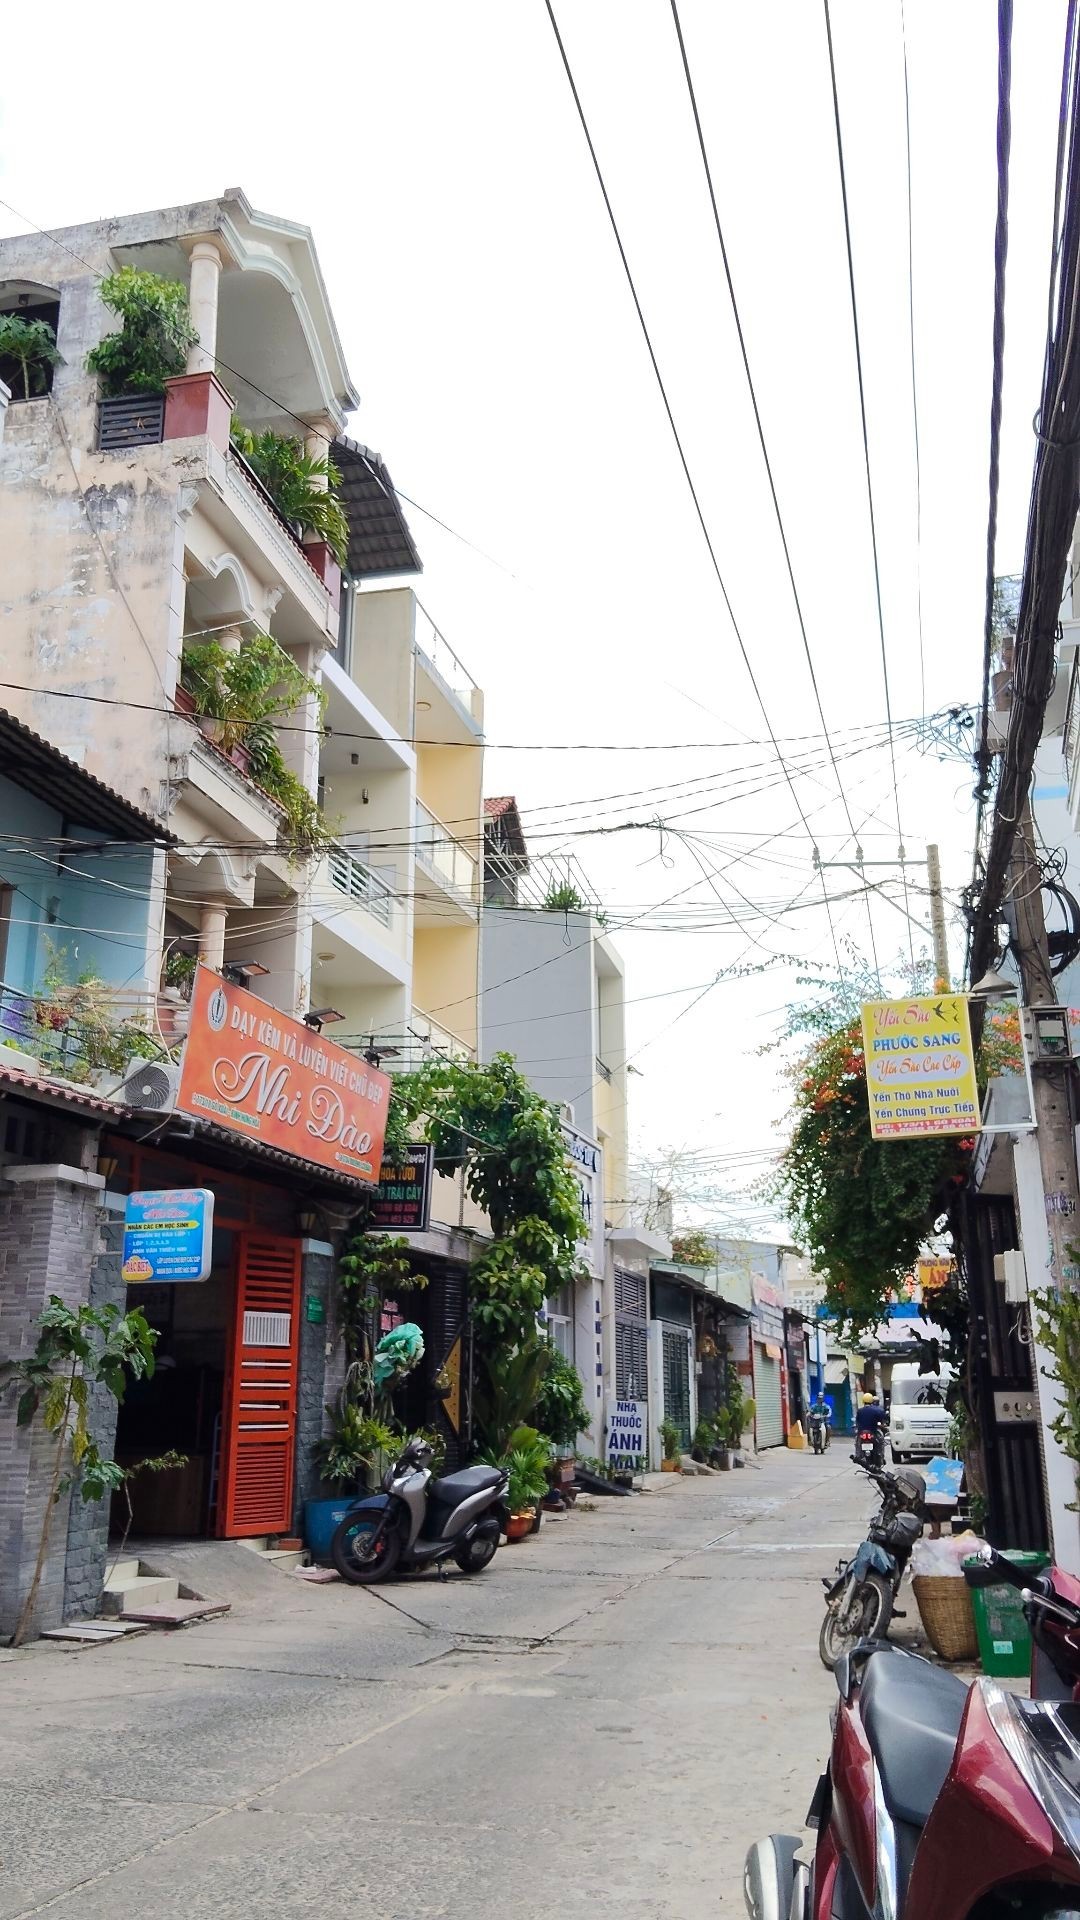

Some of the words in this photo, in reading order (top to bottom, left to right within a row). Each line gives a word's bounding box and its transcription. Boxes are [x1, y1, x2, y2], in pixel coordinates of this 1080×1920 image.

[231, 1005, 257, 1040] DẠY
[257, 1018, 281, 1051] KÈM
[283, 1033, 297, 1061] VÀ
[298, 1044, 328, 1079] LUYỆN
[330, 1058, 350, 1086] VIẾT
[873, 1033, 919, 1052] PHƯỚC
[922, 1032, 961, 1048] SANG
[212, 1052, 302, 1126] Nhi
[306, 1084, 373, 1155] Đào
[873, 1090, 891, 1103] Yến
[914, 1088, 934, 1100] Nhà
[874, 1106, 893, 1119] Yến
[896, 1106, 926, 1118] Chưng
[929, 1104, 951, 1117] Trực
[953, 1100, 975, 1113] Tiếp
[610, 1412, 642, 1429] THUỐC
[608, 1428, 642, 1451] ÁNH
